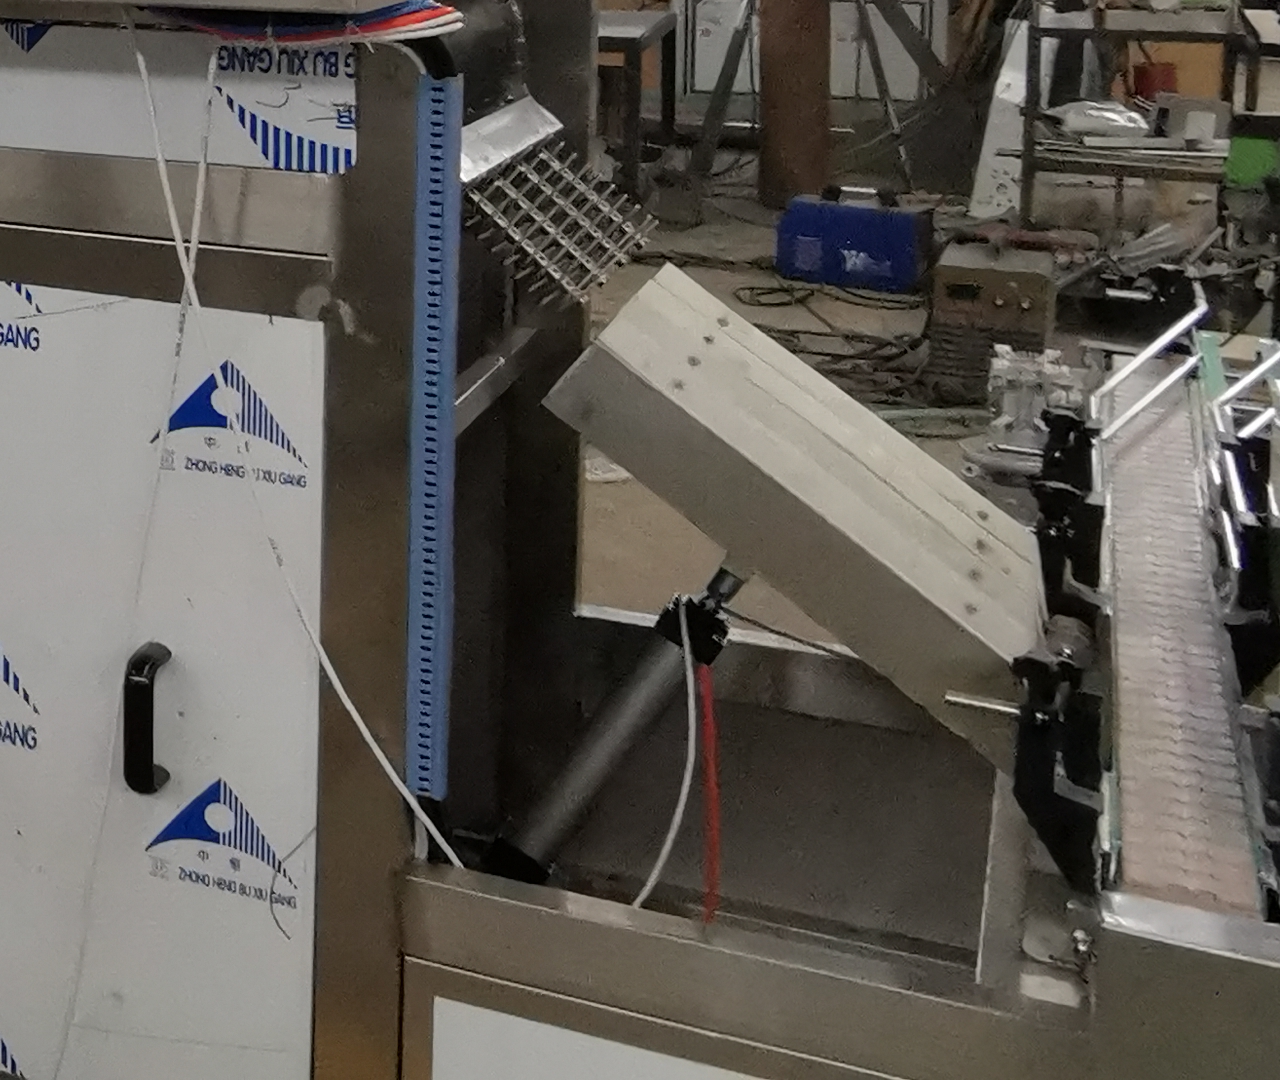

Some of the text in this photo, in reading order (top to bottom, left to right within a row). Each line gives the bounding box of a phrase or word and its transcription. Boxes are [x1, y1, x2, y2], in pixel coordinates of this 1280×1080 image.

[218, 46, 272, 73] GANG
[278, 49, 308, 76] XIU
[313, 51, 338, 78] BU
[184, 456, 218, 474] ZHONG
[220, 463, 245, 479] HENG
[278, 472, 307, 489] GANG
